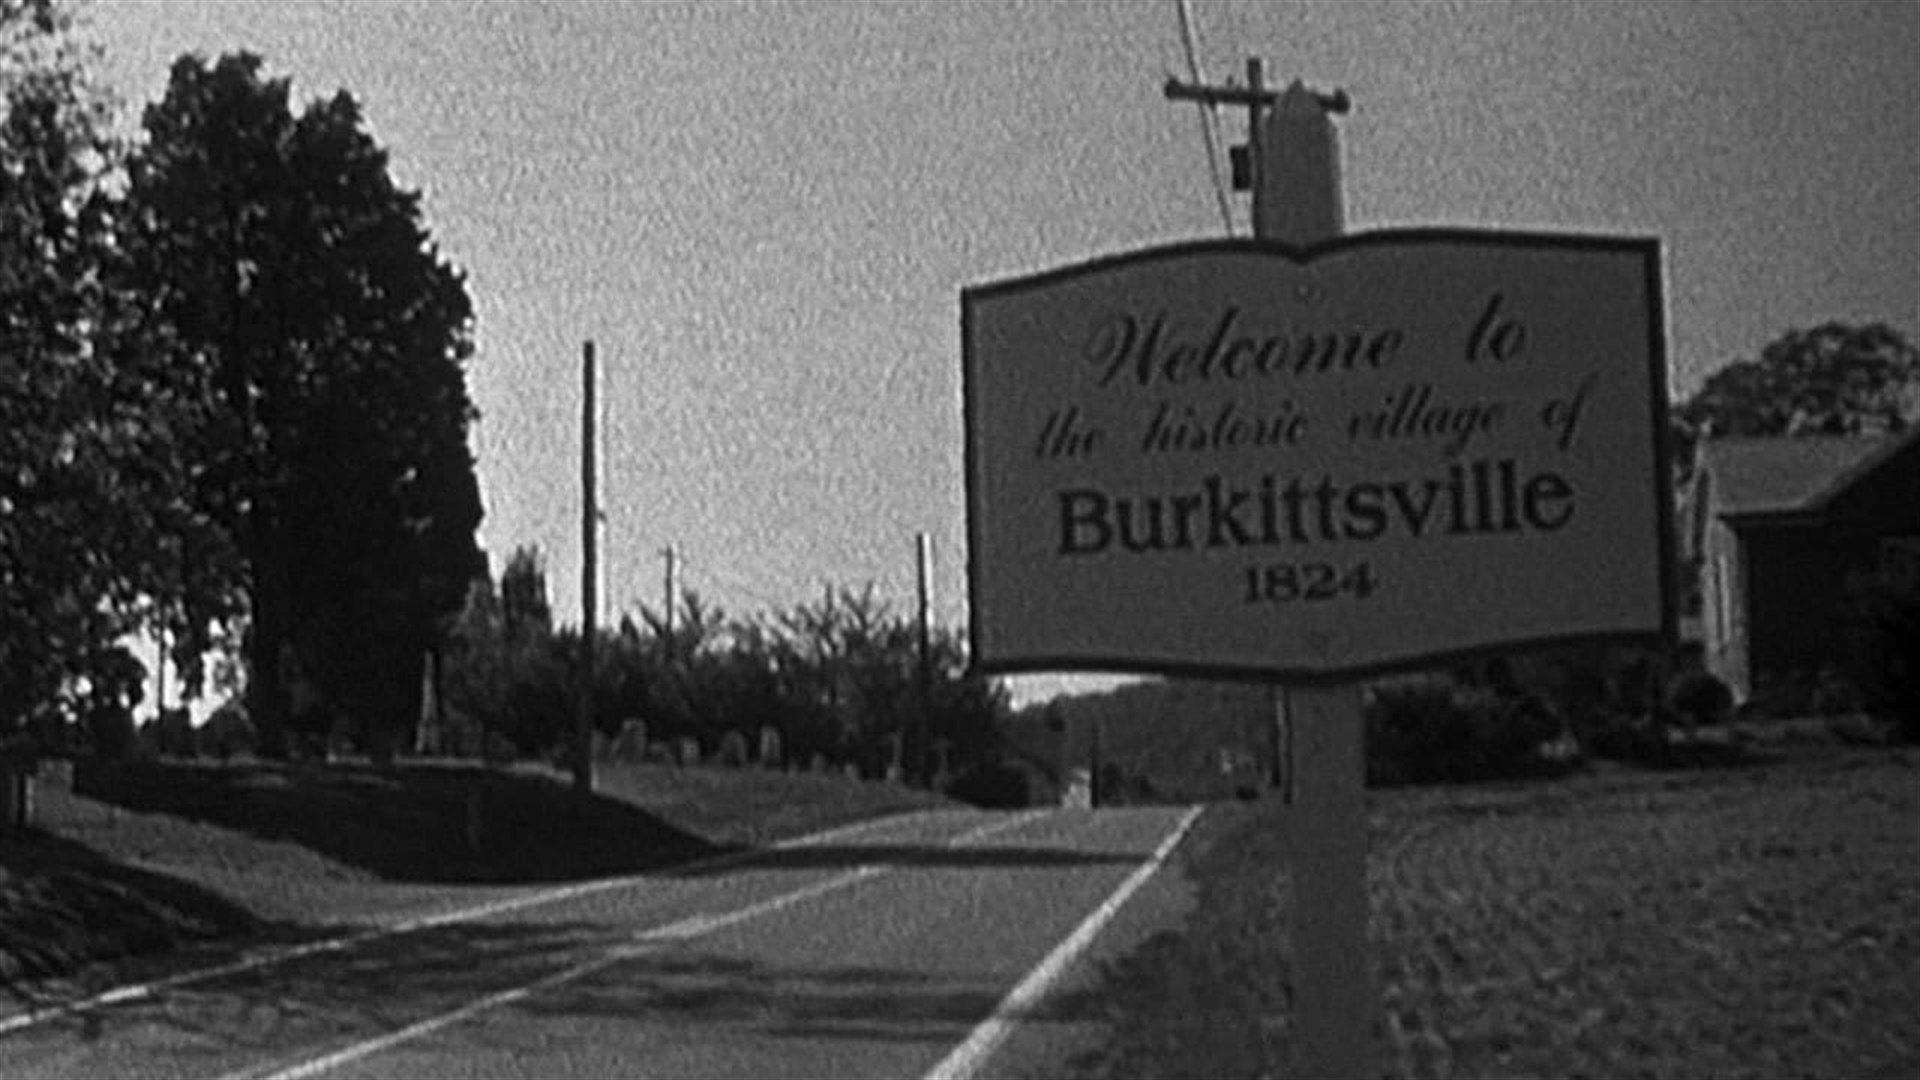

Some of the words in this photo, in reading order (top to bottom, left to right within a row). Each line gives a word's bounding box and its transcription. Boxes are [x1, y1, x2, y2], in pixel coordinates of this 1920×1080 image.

[1088, 306, 1402, 387] Welcome
[1465, 293, 1526, 363] to
[1036, 405, 1102, 459] the
[1141, 400, 1306, 453] historic
[1347, 383, 1500, 457] village
[1541, 372, 1598, 450] of
[1057, 458, 1575, 555] Burkittsville
[1244, 561, 1378, 601] 1824
